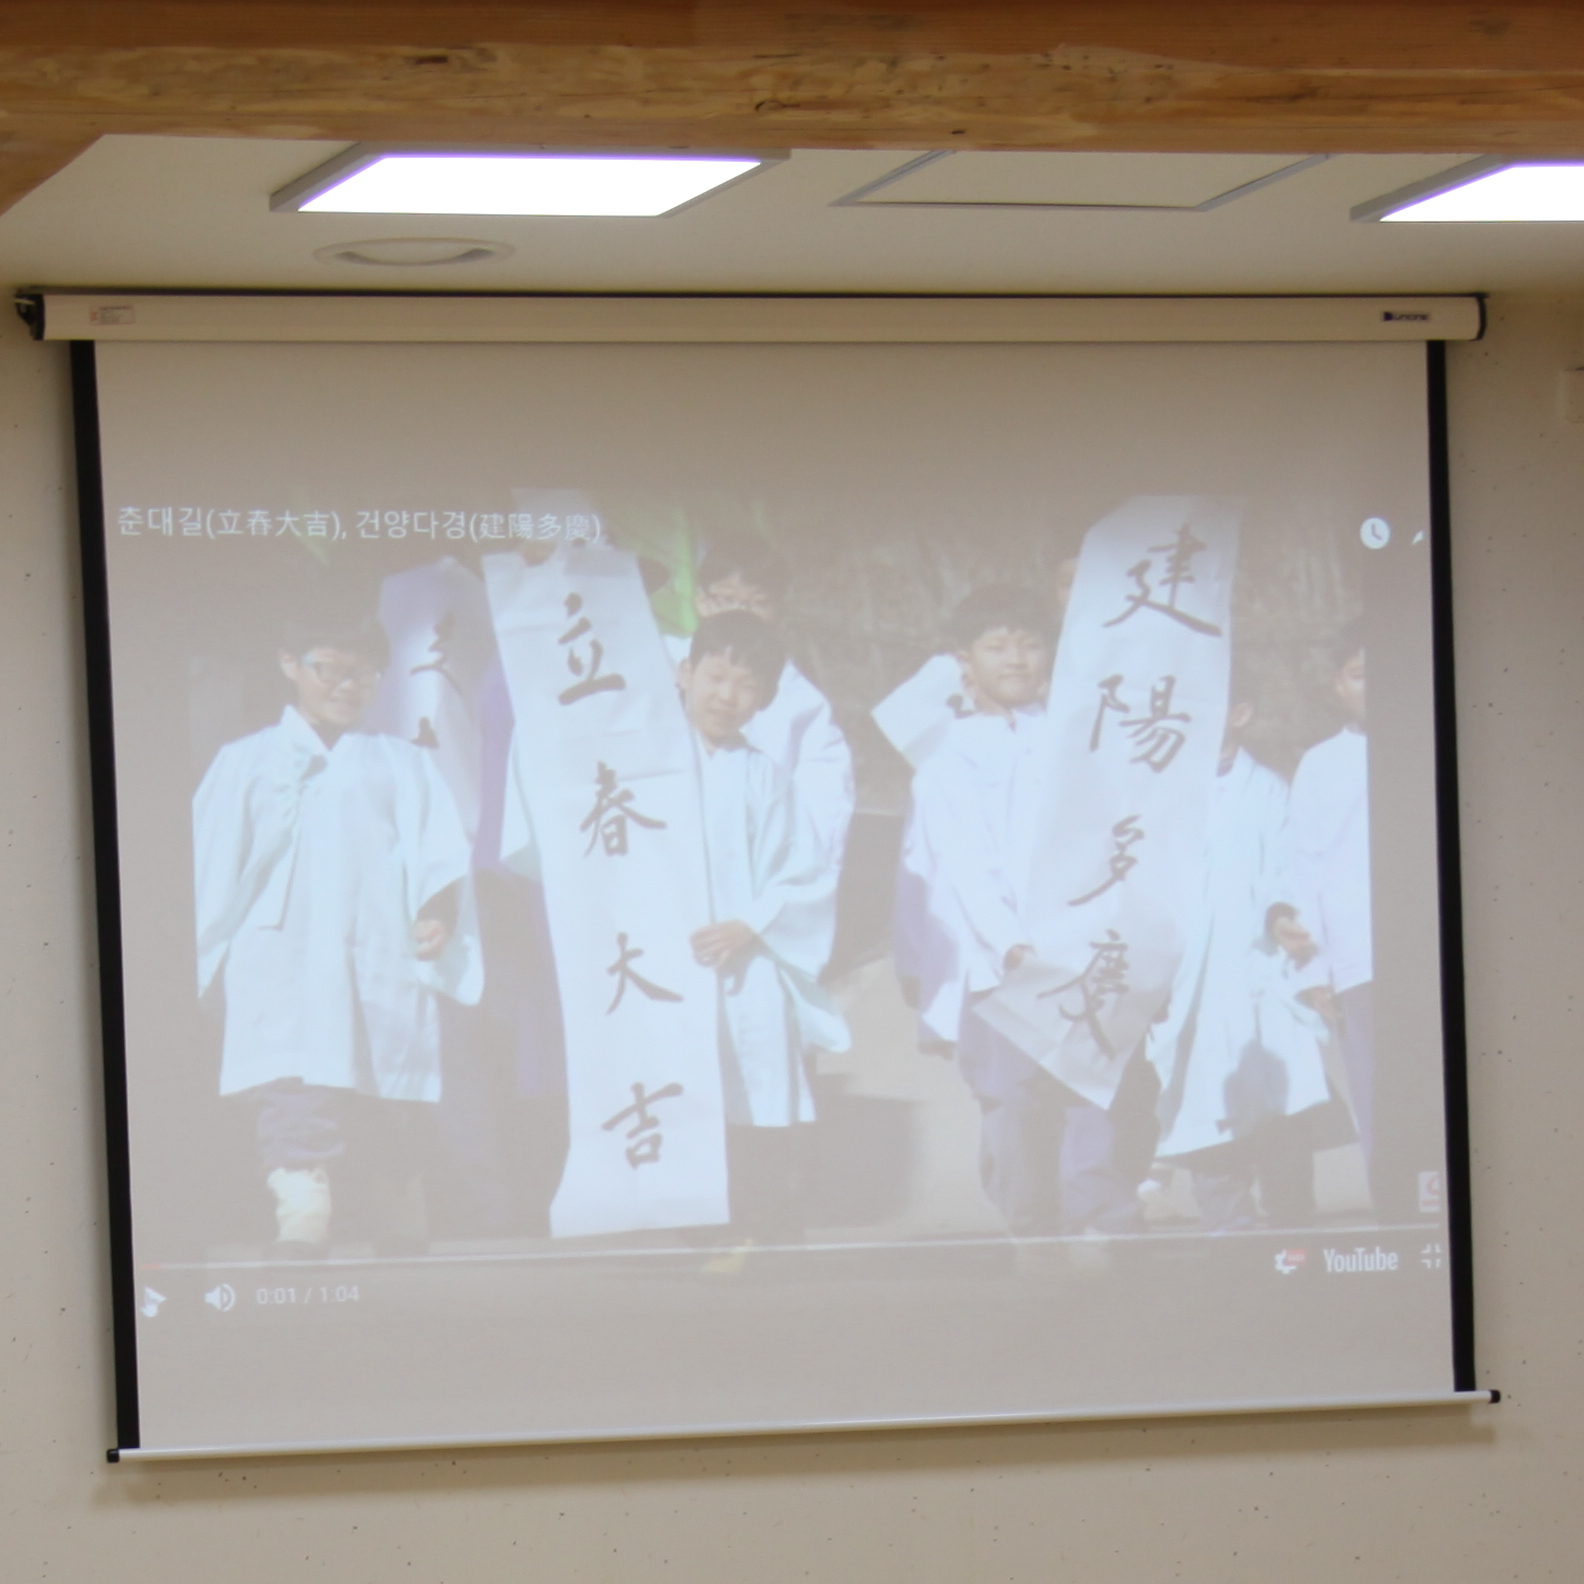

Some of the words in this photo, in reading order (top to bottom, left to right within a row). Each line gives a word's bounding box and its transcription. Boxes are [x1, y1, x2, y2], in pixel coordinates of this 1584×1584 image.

[558, 592, 685, 1171] 立春大吉
[1322, 1246, 1399, 1273] YouTube
[255, 1287, 297, 1305] 0:01
[319, 1285, 361, 1303] 1:04
